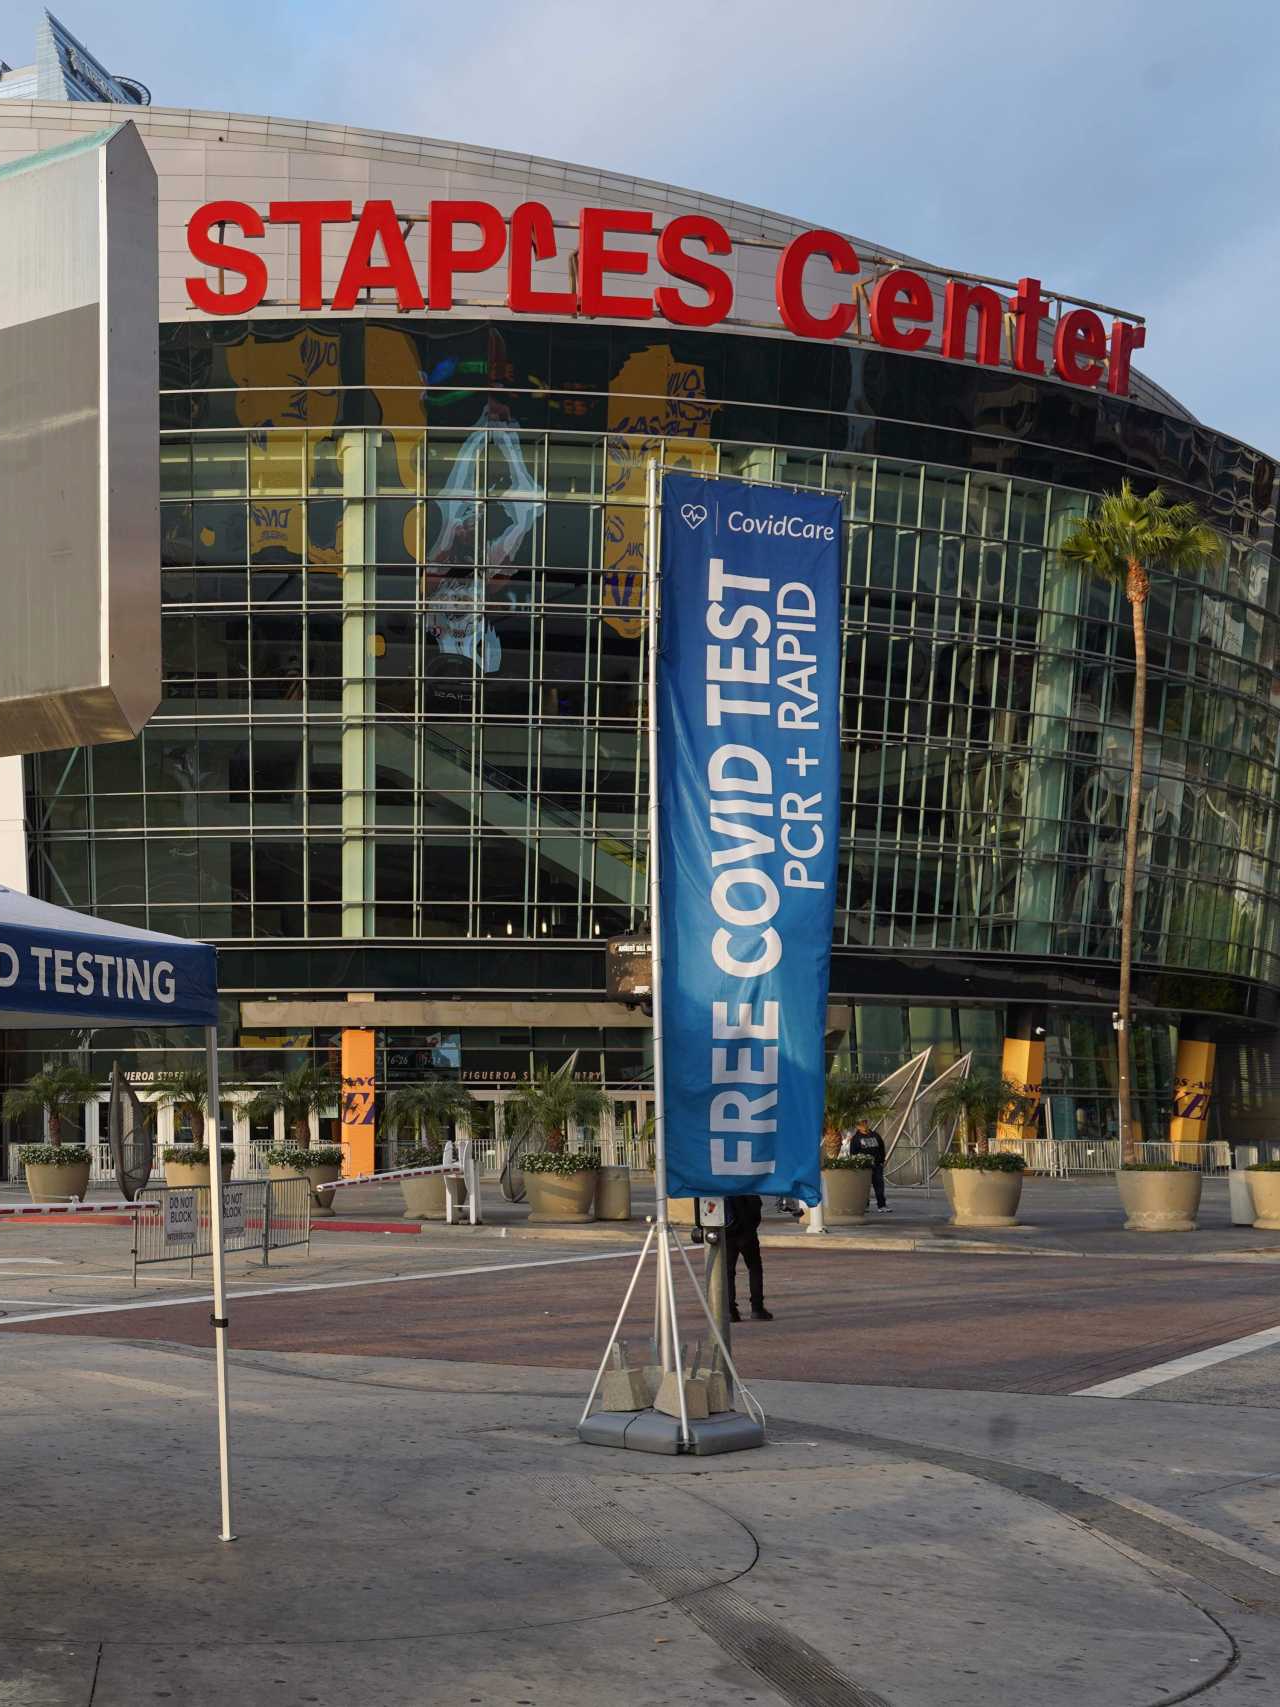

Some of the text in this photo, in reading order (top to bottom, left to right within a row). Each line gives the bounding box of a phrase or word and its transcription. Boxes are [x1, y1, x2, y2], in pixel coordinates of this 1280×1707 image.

[185, 200, 1146, 396] STAPLES Center
[728, 511, 835, 542] CovidCare
[776, 582, 820, 730] RAPID
[706, 559, 782, 1176] FREE COVID TEST
[780, 792, 825, 890] PCR
[31, 946, 176, 1004] TESTING
[463, 1071, 517, 1081] FIGUEROA
[181, 1196, 193, 1208] NOT
